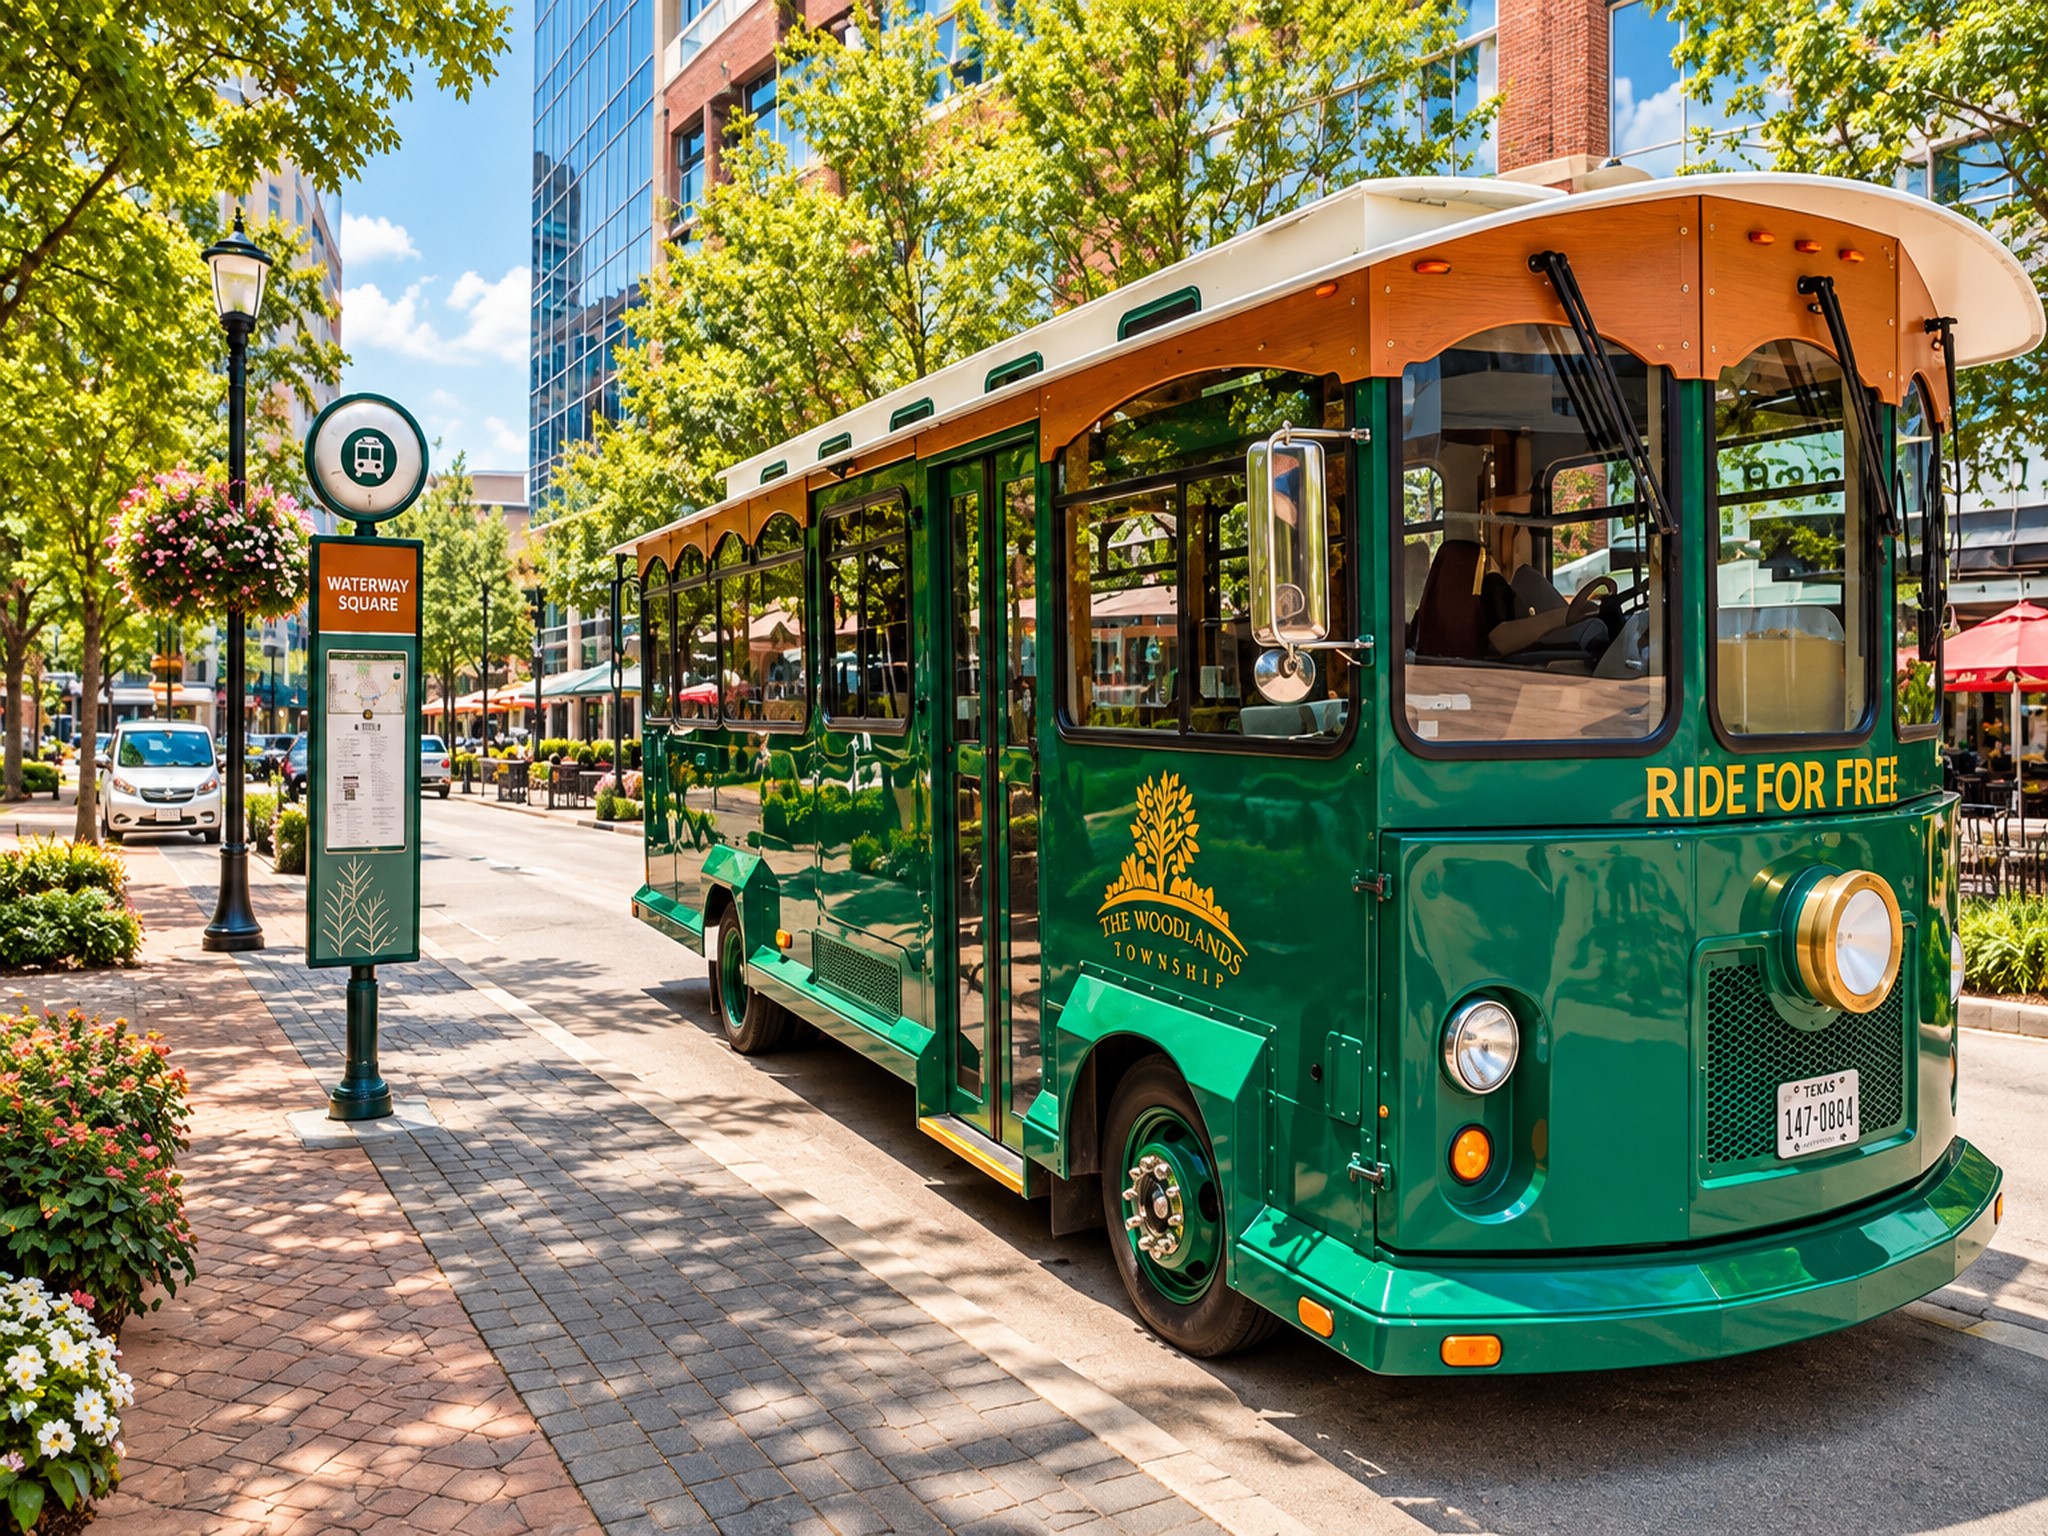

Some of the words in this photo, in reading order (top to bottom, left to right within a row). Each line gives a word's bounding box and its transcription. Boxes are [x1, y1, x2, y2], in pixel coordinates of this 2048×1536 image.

[327, 576, 409, 593] WATERWAY
[338, 595, 398, 614] SQUARE
[1646, 764, 1746, 818] RIDE
[1757, 761, 1826, 813] FOR
[1836, 755, 1898, 807] FREE
[1100, 911, 1131, 938] THE
[1133, 910, 1242, 976] WOODLANDS
[1114, 941, 1224, 989] TOWNSHIP
[1803, 1080, 1835, 1098] TEXAS
